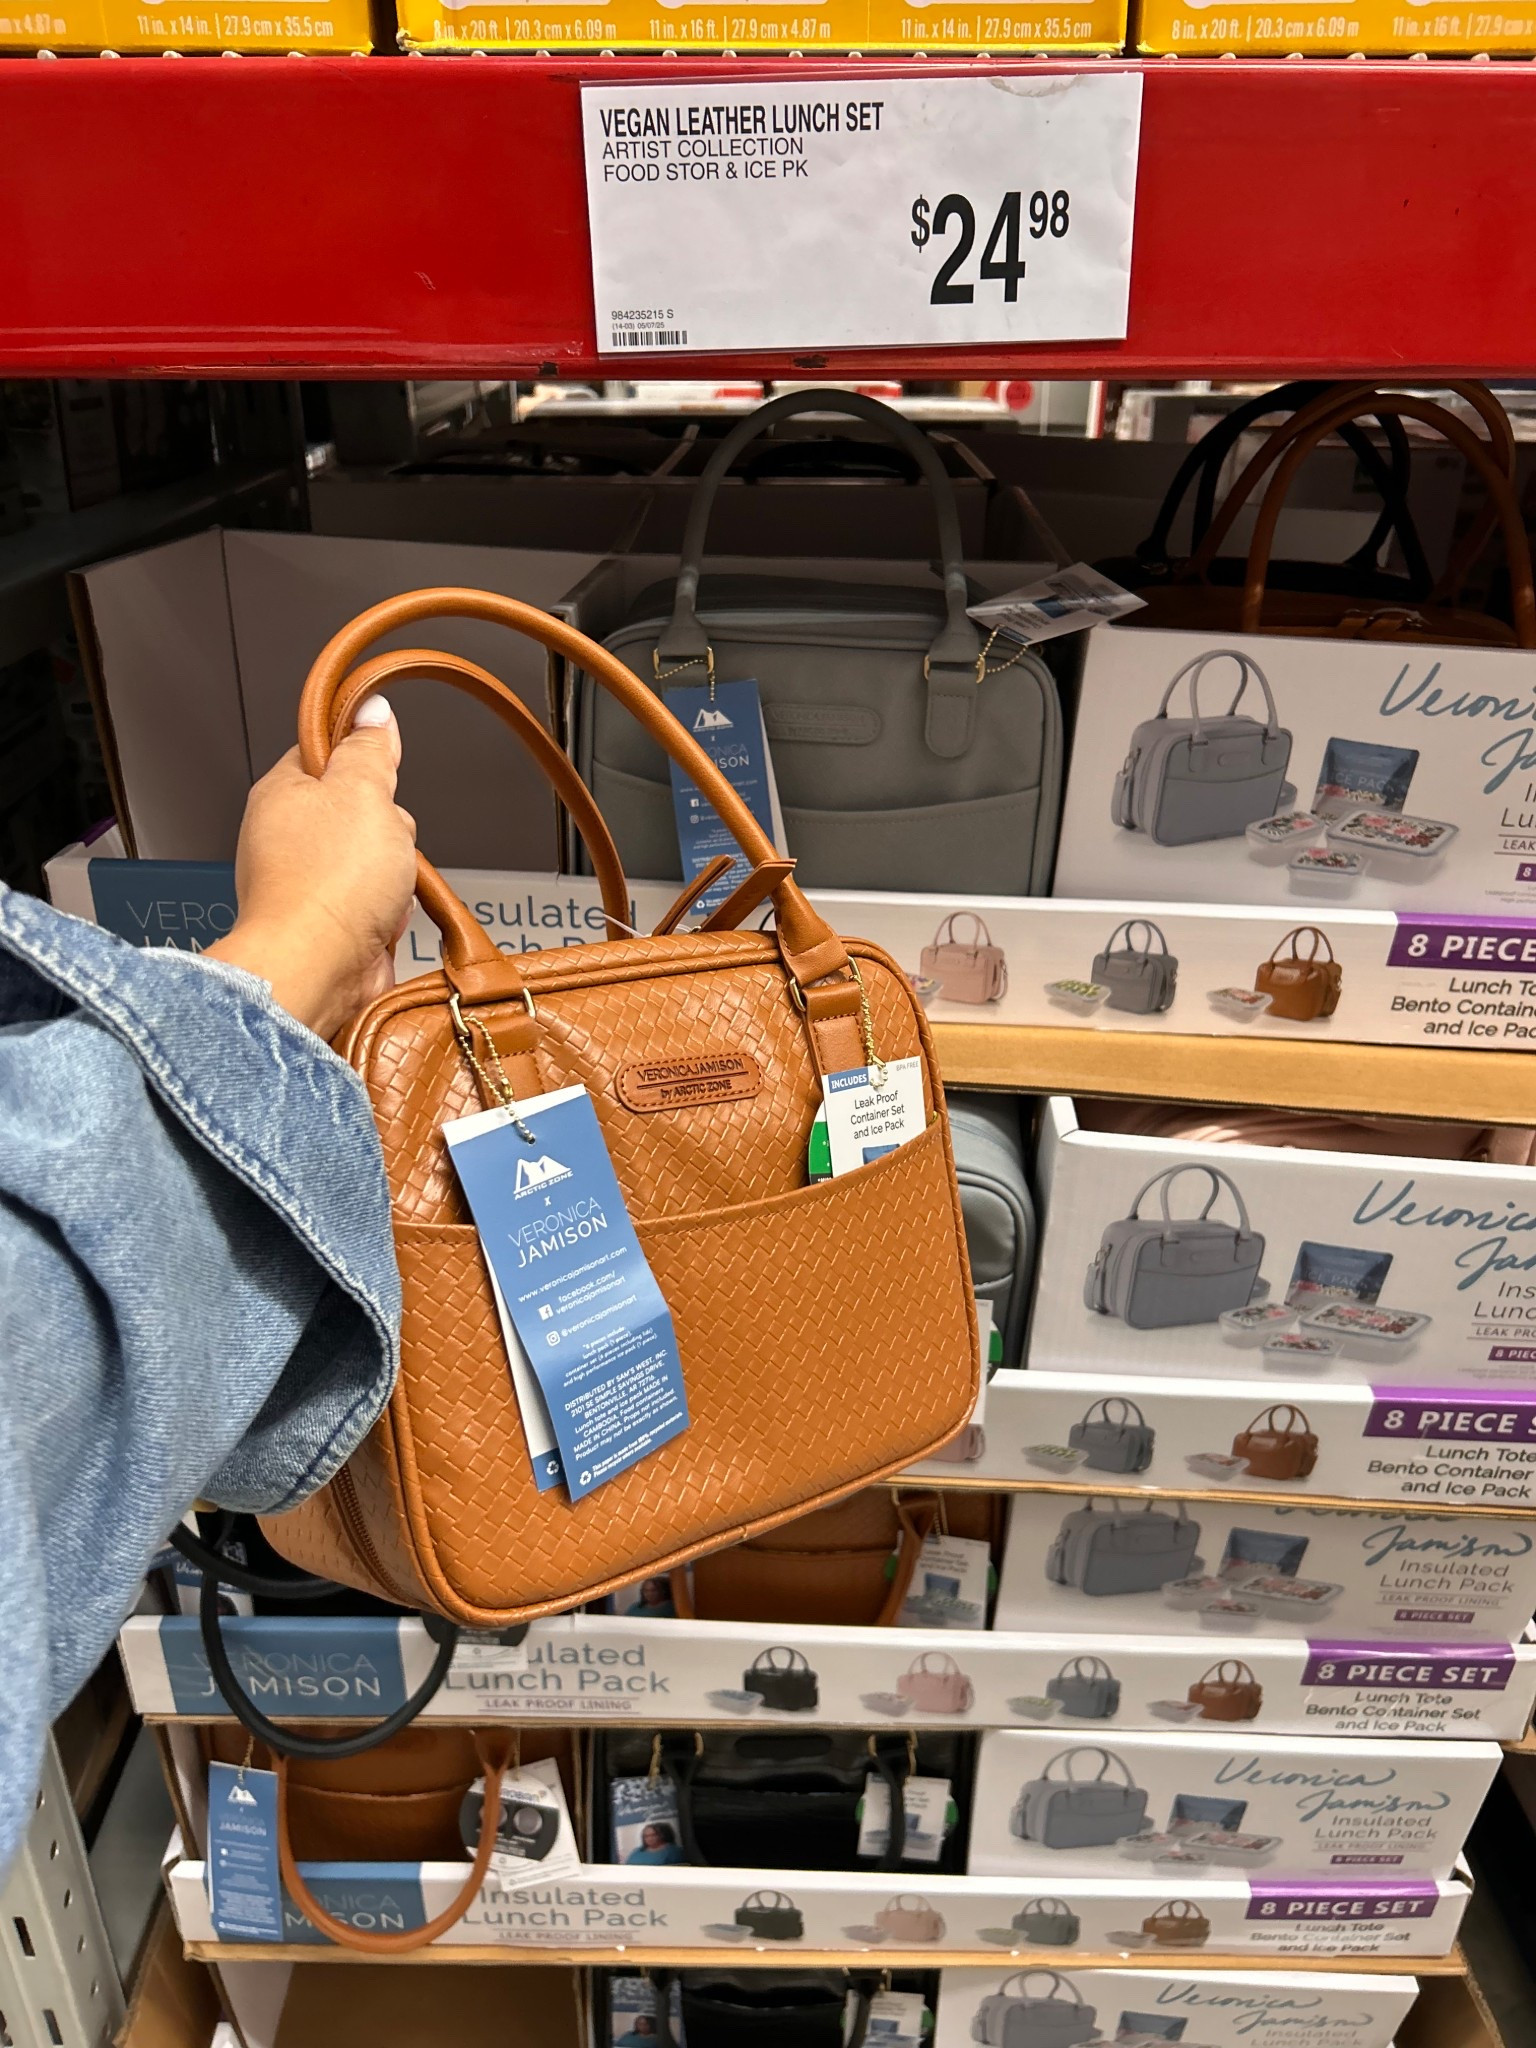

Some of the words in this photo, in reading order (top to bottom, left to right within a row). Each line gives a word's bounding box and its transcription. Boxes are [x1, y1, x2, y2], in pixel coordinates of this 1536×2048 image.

[902, 19, 911, 38] 11
[915, 19, 929, 38] in.
[931, 26, 939, 37] x
[942, 19, 955, 38] 14
[958, 19, 971, 38] in.
[985, 18, 1011, 38] 27.9
[1014, 25, 1031, 38] cm
[1034, 25, 1042, 37] x
[1045, 18, 1071, 38] 35.5
[1073, 24, 1092, 38] cm
[1172, 19, 1179, 40] 8
[1211, 19, 1227, 39] 20
[1255, 18, 1283, 39] 20.3
[1285, 25, 1304, 38] cm
[1316, 17, 1345, 38] 6.09
[600, 108, 670, 137] VEGAN
[676, 105, 766, 136] LEATHER
[772, 103, 839, 133] LUNCH
[846, 101, 884, 131] SET
[602, 141, 672, 160] ARTIST
[677, 137, 803, 158] COLLECTION
[603, 164, 660, 182] FOOD
[666, 162, 719, 181] STOR
[725, 162, 738, 179] &
[745, 160, 776, 178] ICE
[783, 159, 808, 178] PK
[611, 309, 664, 321] 984235215
[666, 308, 674, 319] S
[612, 322, 635, 331] (14-03)
[637, 321, 665, 330] 05/07/25
[1522, 866, 1532, 878] 8
[1408, 933, 1429, 957] 8
[1441, 935, 1536, 963] PIECE
[1449, 976, 1512, 996] Lunch
[1391, 996, 1451, 1014] Bento
[1457, 999, 1536, 1018] Contain
[1424, 1020, 1463, 1035] and
[1468, 1021, 1498, 1037] Ice
[896, 1062, 906, 1072] BPA
[906, 1060, 919, 1070] FREE
[660, 1087, 673, 1101] by
[673, 1082, 707, 1098] ARCTIC
[707, 1079, 733, 1095] ZONE
[831, 1073, 868, 1090] INCLUDES
[854, 1095, 876, 1110] Leak
[877, 1090, 899, 1105] Proof
[850, 1108, 890, 1126] Container
[891, 1104, 905, 1116] Set
[854, 1125, 870, 1139] and
[871, 1122, 883, 1136] Ice
[885, 1118, 905, 1133] Pack
[514, 1181, 548, 1200] ARCTIC
[548, 1171, 574, 1187] ZONE
[508, 1197, 602, 1247] VERONICA
[517, 1212, 608, 1268] JAMISON
[558, 1270, 616, 1303] facebook.com/
[1476, 1326, 1508, 1337] LEAK
[564, 1383, 605, 1410] DISTRIBUTED
[606, 1378, 614, 1387] BY
[594, 1386, 616, 1403] SIMPLE
[574, 1419, 593, 1433] Lunch
[1383, 1409, 1405, 1429] 8
[1417, 1410, 1518, 1435] PIECE
[573, 1437, 592, 1452] MADE
[1426, 1445, 1489, 1462] Lunch
[1496, 1447, 1536, 1463] Tote
[1367, 1460, 1428, 1475] Bento
[1434, 1463, 1534, 1480] Container
[1401, 1480, 1441, 1494] and
[1445, 1482, 1476, 1496] Ice
[1481, 1483, 1532, 1499] Pack
[1400, 1558, 1510, 1578] Insulated
[1379, 1574, 1452, 1591] Lunch
[1459, 1577, 1515, 1593] Pack
[578, 1669, 671, 1694] Pack
[1317, 1662, 1337, 1680] 8
[1347, 1663, 1433, 1683] PIECE
[1442, 1666, 1498, 1684] SET
[200, 1675, 381, 1697] JMISON
[1355, 1690, 1410, 1704] Lunch
[1415, 1692, 1453, 1706] Tote
[1305, 1703, 1358, 1716] Bento
[1362, 1705, 1447, 1719] Container
[1451, 1707, 1482, 1721] Set
[1335, 1719, 1369, 1731] and
[1373, 1719, 1399, 1731] Ice
[1404, 1720, 1447, 1733] Pack
[1214, 1757, 1396, 1787] Veronica
[1332, 1815, 1432, 1828] Insulated
[1314, 1828, 1380, 1839] Lunch
[1387, 1828, 1438, 1840] Pack
[480, 1886, 645, 1907] Insulated
[463, 1908, 570, 1927] Lunch
[585, 1909, 669, 1928] Pack
[1260, 1901, 1277, 1916] 8
[1287, 1901, 1366, 1916] PIECE
[1373, 1900, 1424, 1915] SET
[1156, 1983, 1323, 2009] Veronica
